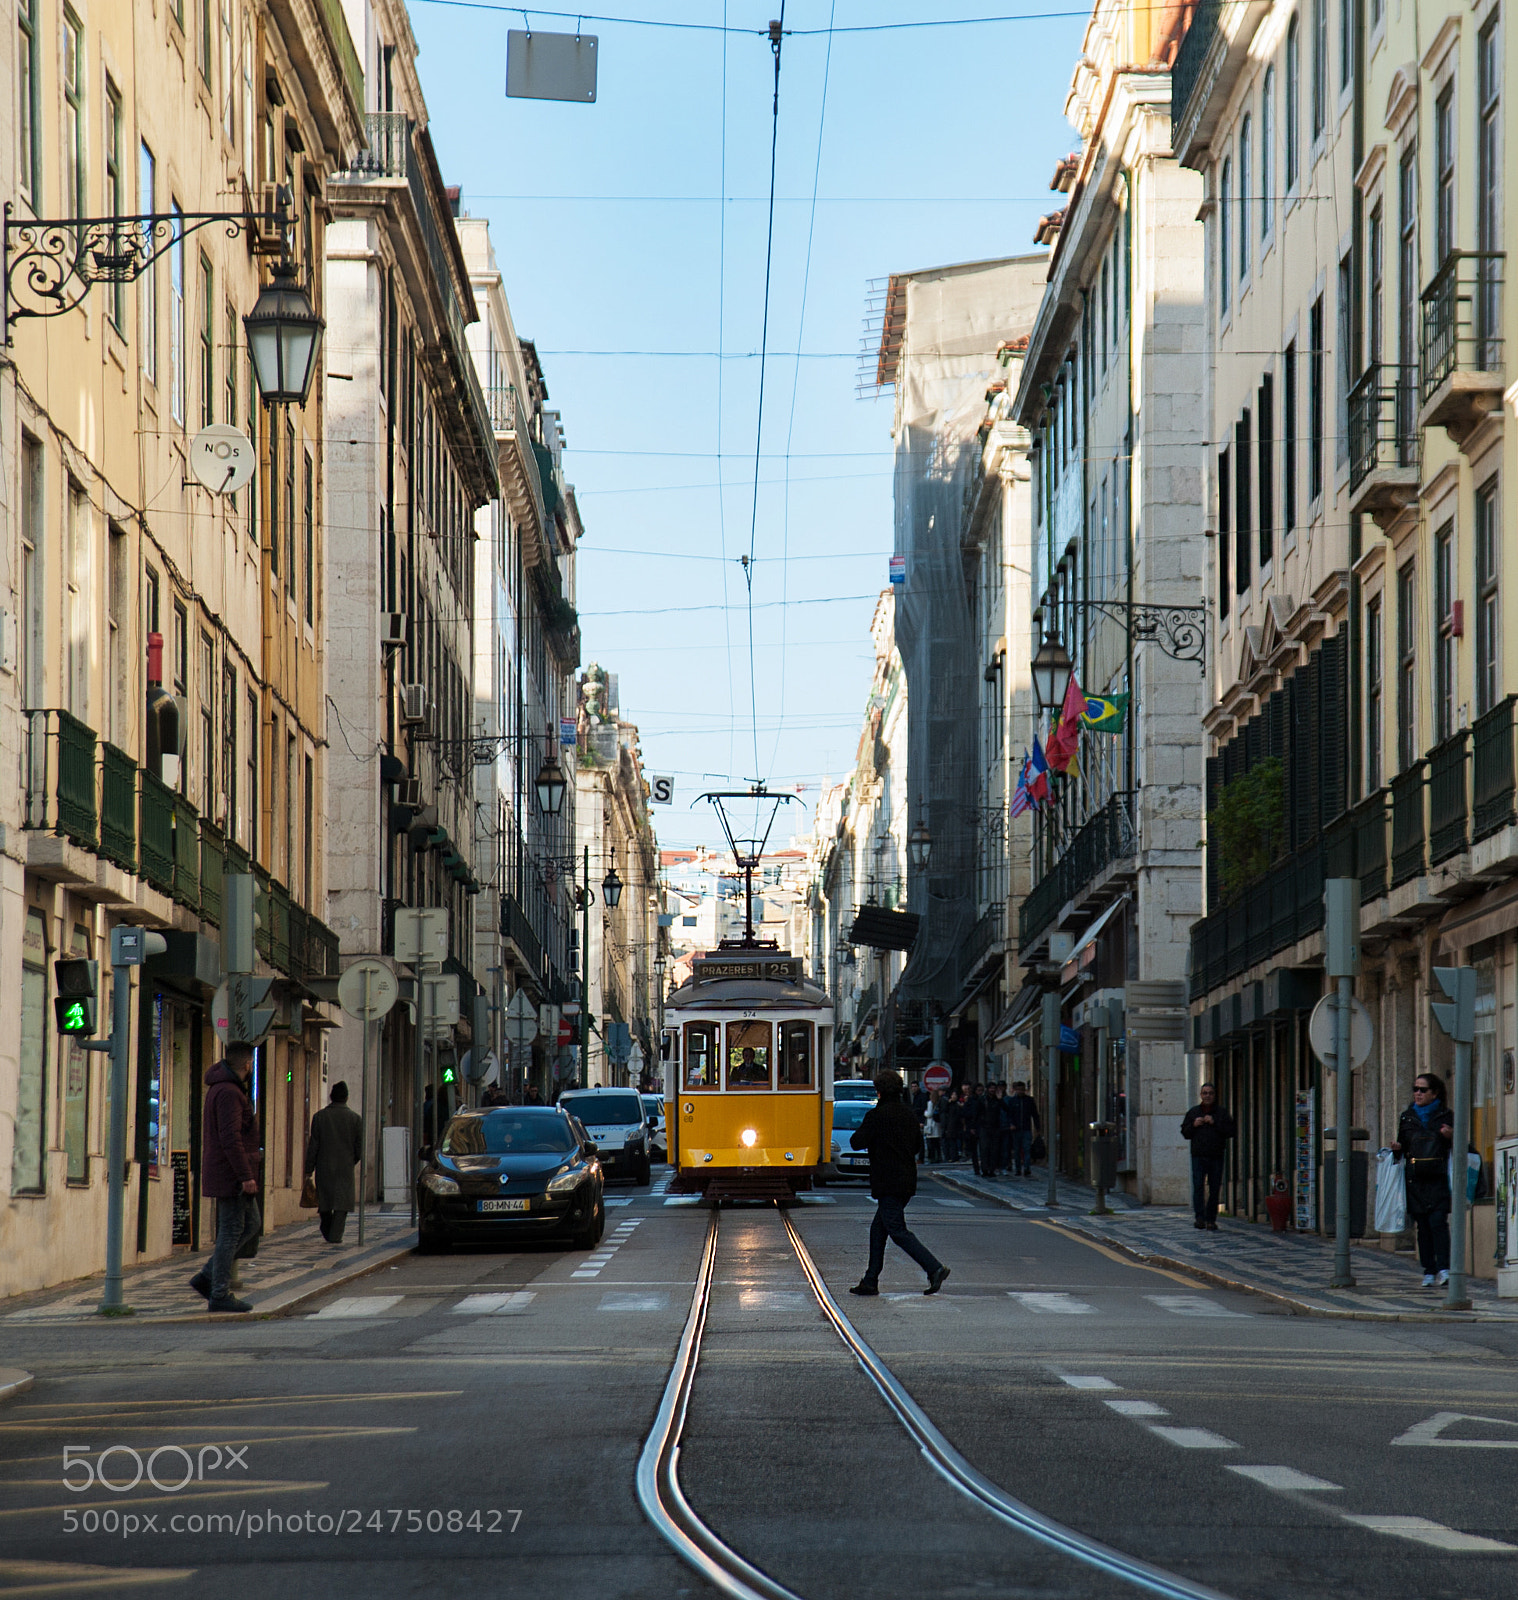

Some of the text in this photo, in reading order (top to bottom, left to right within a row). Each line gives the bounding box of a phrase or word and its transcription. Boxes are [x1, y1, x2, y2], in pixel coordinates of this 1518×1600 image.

[205, 441, 240, 460] NOS
[655, 779, 671, 802] S
[702, 963, 789, 975] PRAZERES 25
[483, 1200, 524, 1211] 80-MN-44
